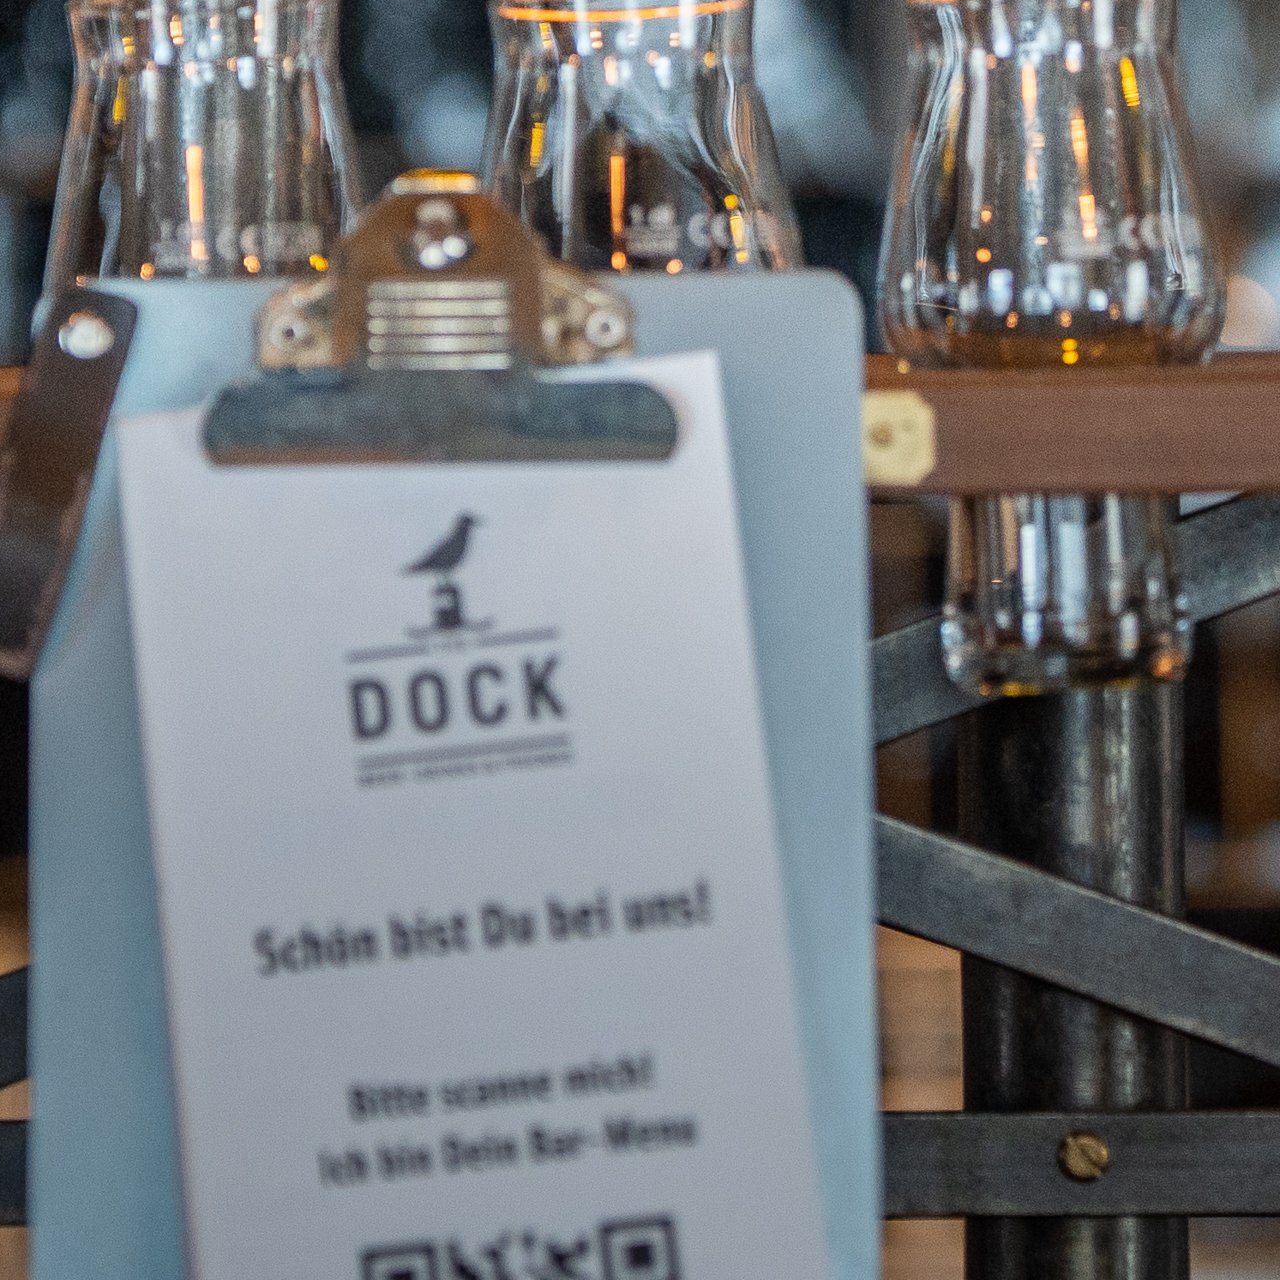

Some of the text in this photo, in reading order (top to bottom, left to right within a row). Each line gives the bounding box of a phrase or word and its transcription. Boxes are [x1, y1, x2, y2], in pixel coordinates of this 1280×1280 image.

[349, 651, 567, 742] DOCK
[253, 875, 713, 978] Schön bist Du bei uns!
